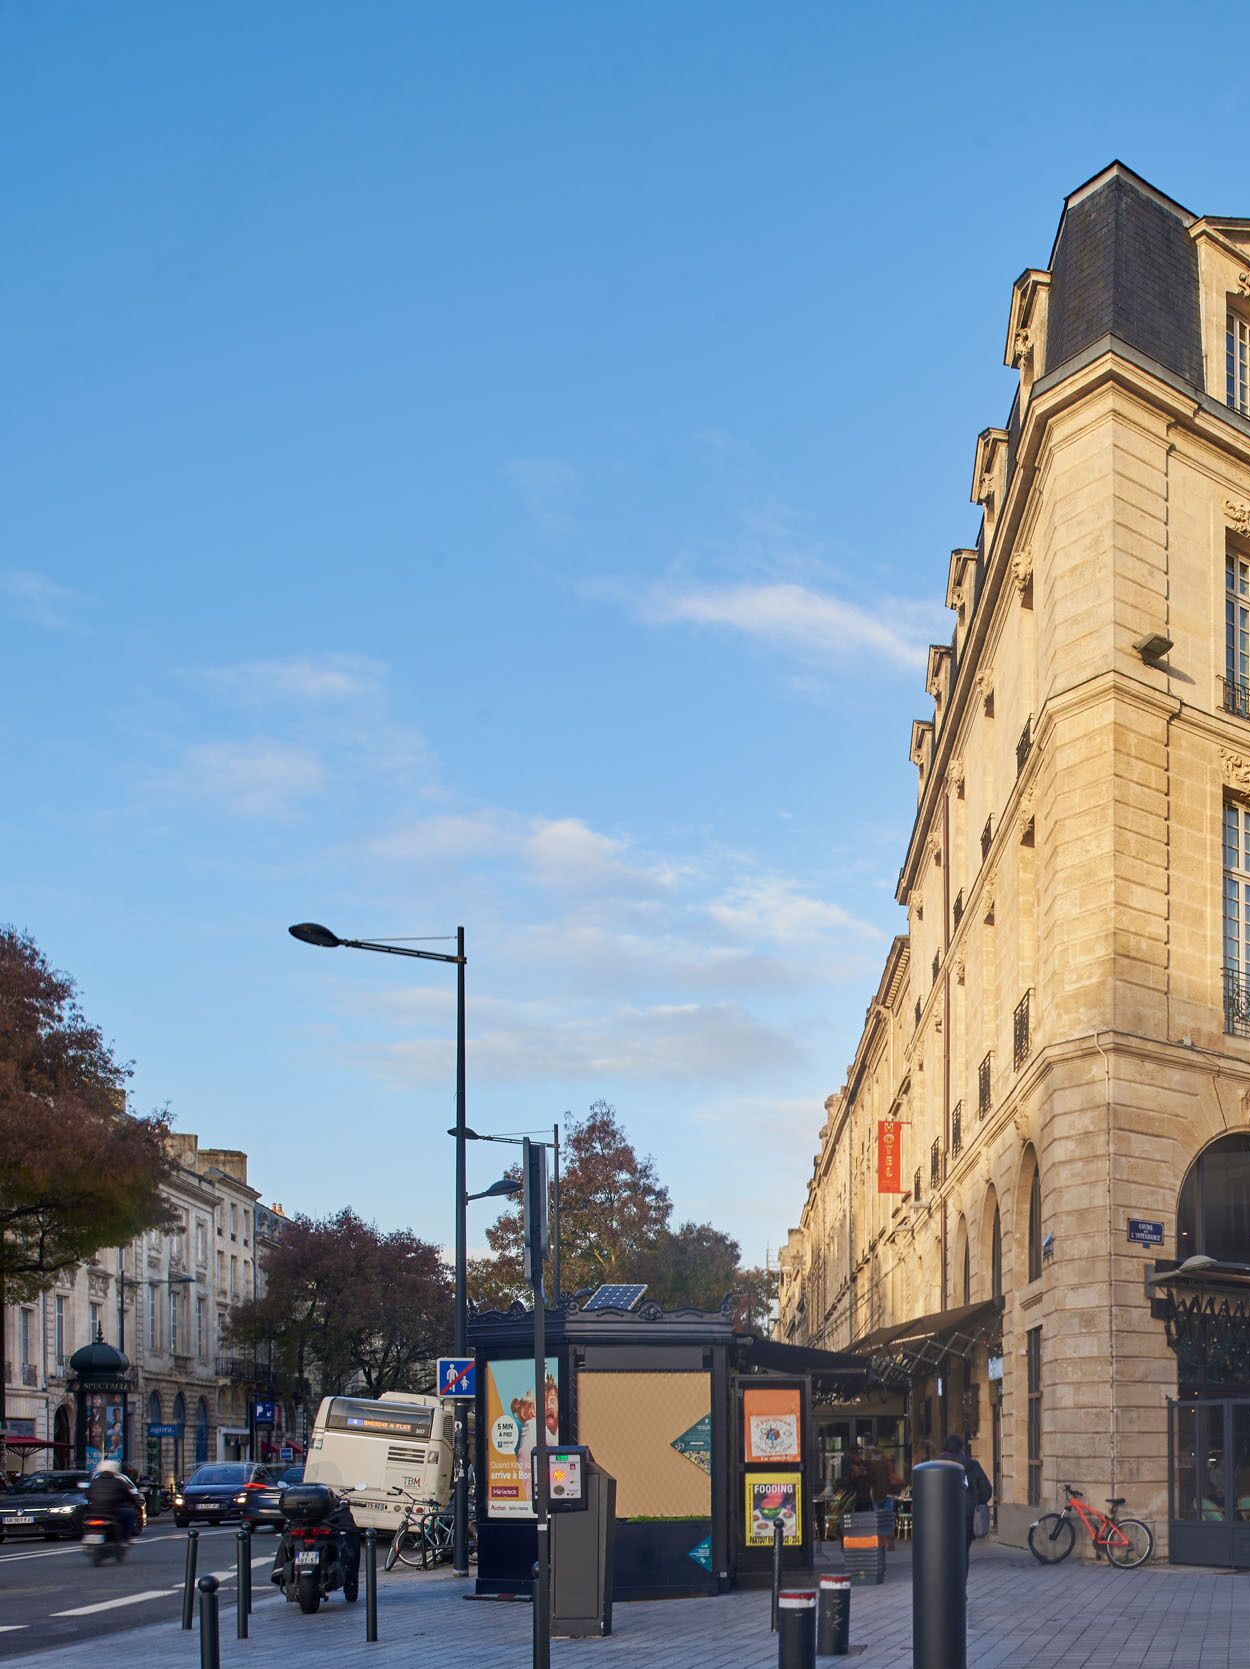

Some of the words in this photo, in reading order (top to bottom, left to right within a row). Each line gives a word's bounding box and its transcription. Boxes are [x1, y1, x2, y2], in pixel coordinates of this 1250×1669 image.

[1138, 1223, 1153, 1231] COURS
[491, 1471, 511, 1480] arrive
[402, 1476, 421, 1488] TBM
[754, 1484, 793, 1494] FOODING
